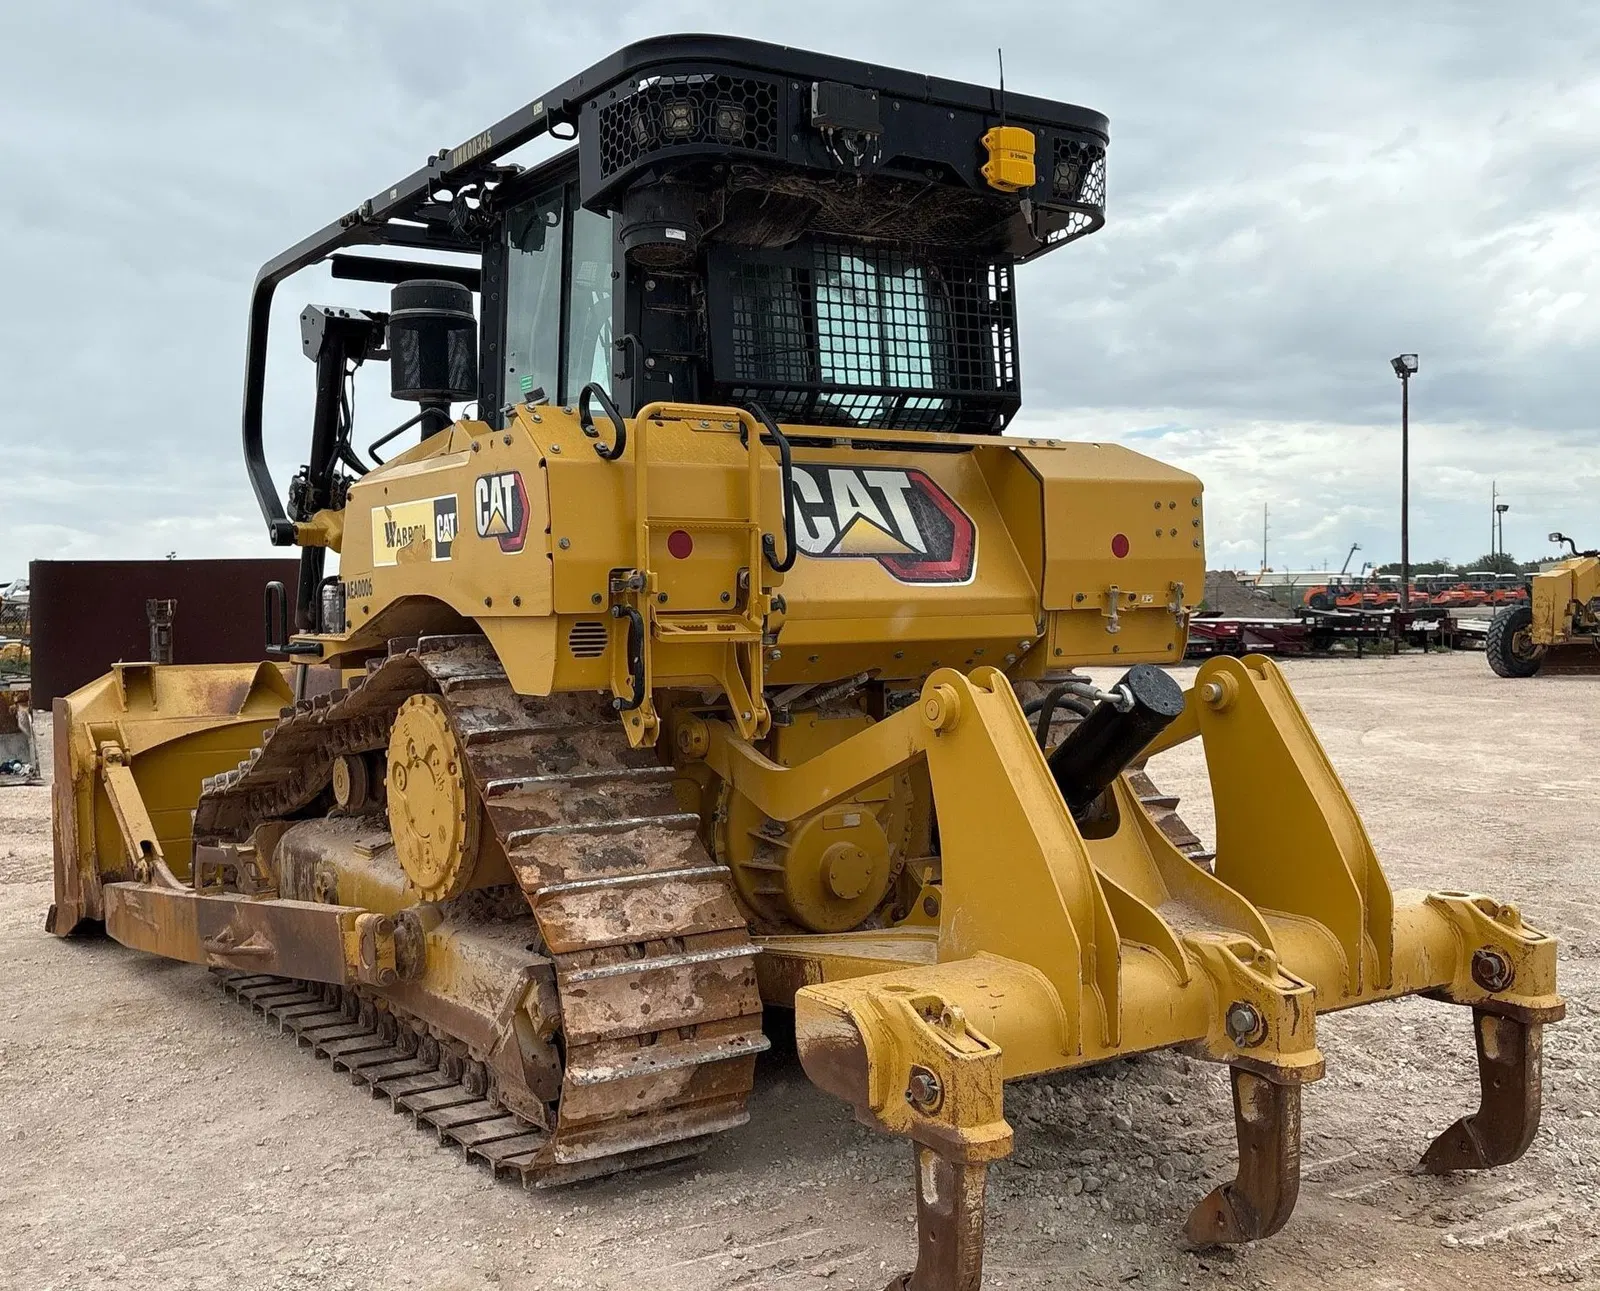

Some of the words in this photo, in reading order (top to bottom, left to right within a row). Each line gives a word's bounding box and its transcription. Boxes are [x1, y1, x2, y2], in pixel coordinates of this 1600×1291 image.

[436, 512, 456, 543] CAT
[475, 473, 515, 537] CAT
[790, 466, 928, 554] CAT
